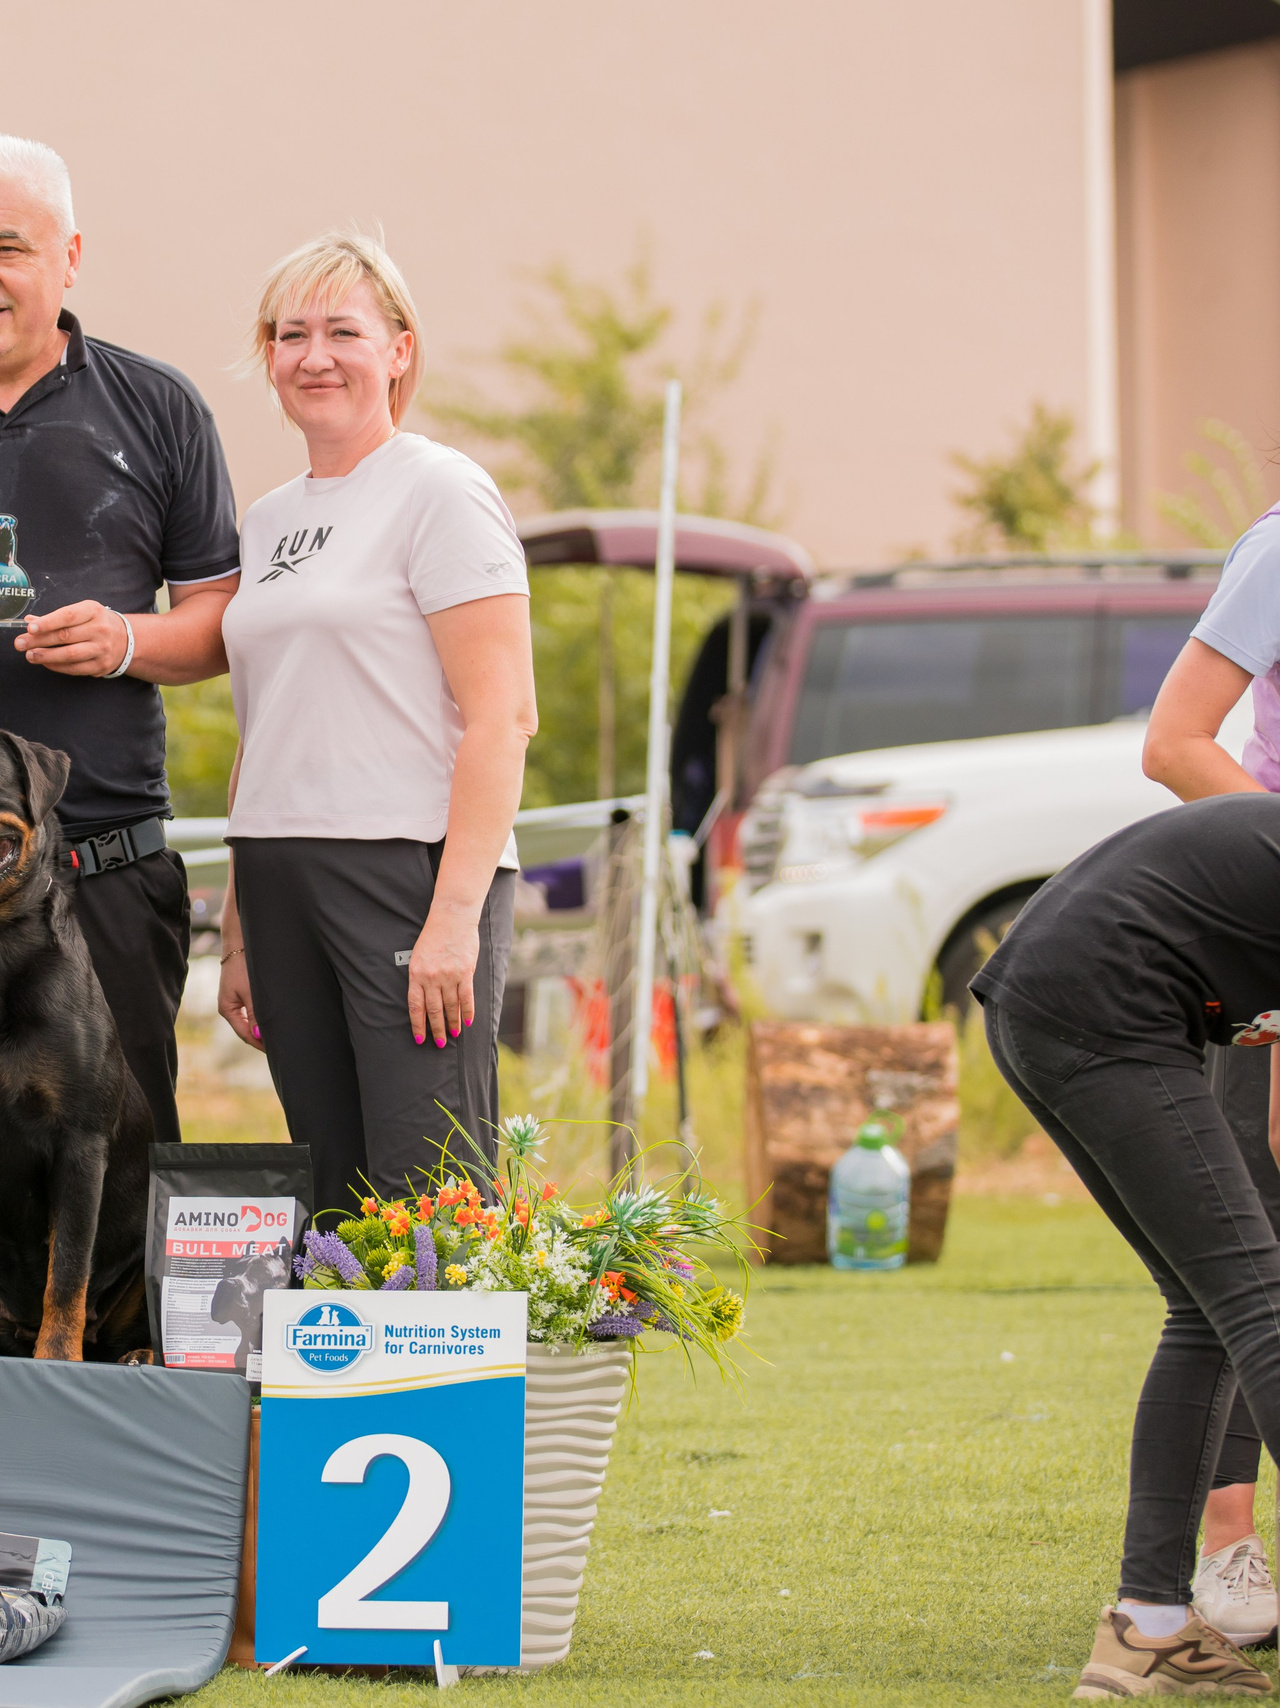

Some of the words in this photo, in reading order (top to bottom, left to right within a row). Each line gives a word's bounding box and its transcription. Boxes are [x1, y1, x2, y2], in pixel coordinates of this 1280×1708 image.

[270, 526, 334, 562] RUN
[172, 1242, 222, 1255] BULL
[232, 1243, 286, 1256] MEAT
[292, 1328, 367, 1347] Farmina
[384, 1324, 445, 1338] Nutrition
[450, 1325, 501, 1341] System
[384, 1341, 404, 1354] for
[408, 1341, 485, 1355] Carnivores
[309, 1352, 322, 1362] Pet
[324, 1352, 349, 1362] Foods
[317, 1433, 451, 1631] 2
